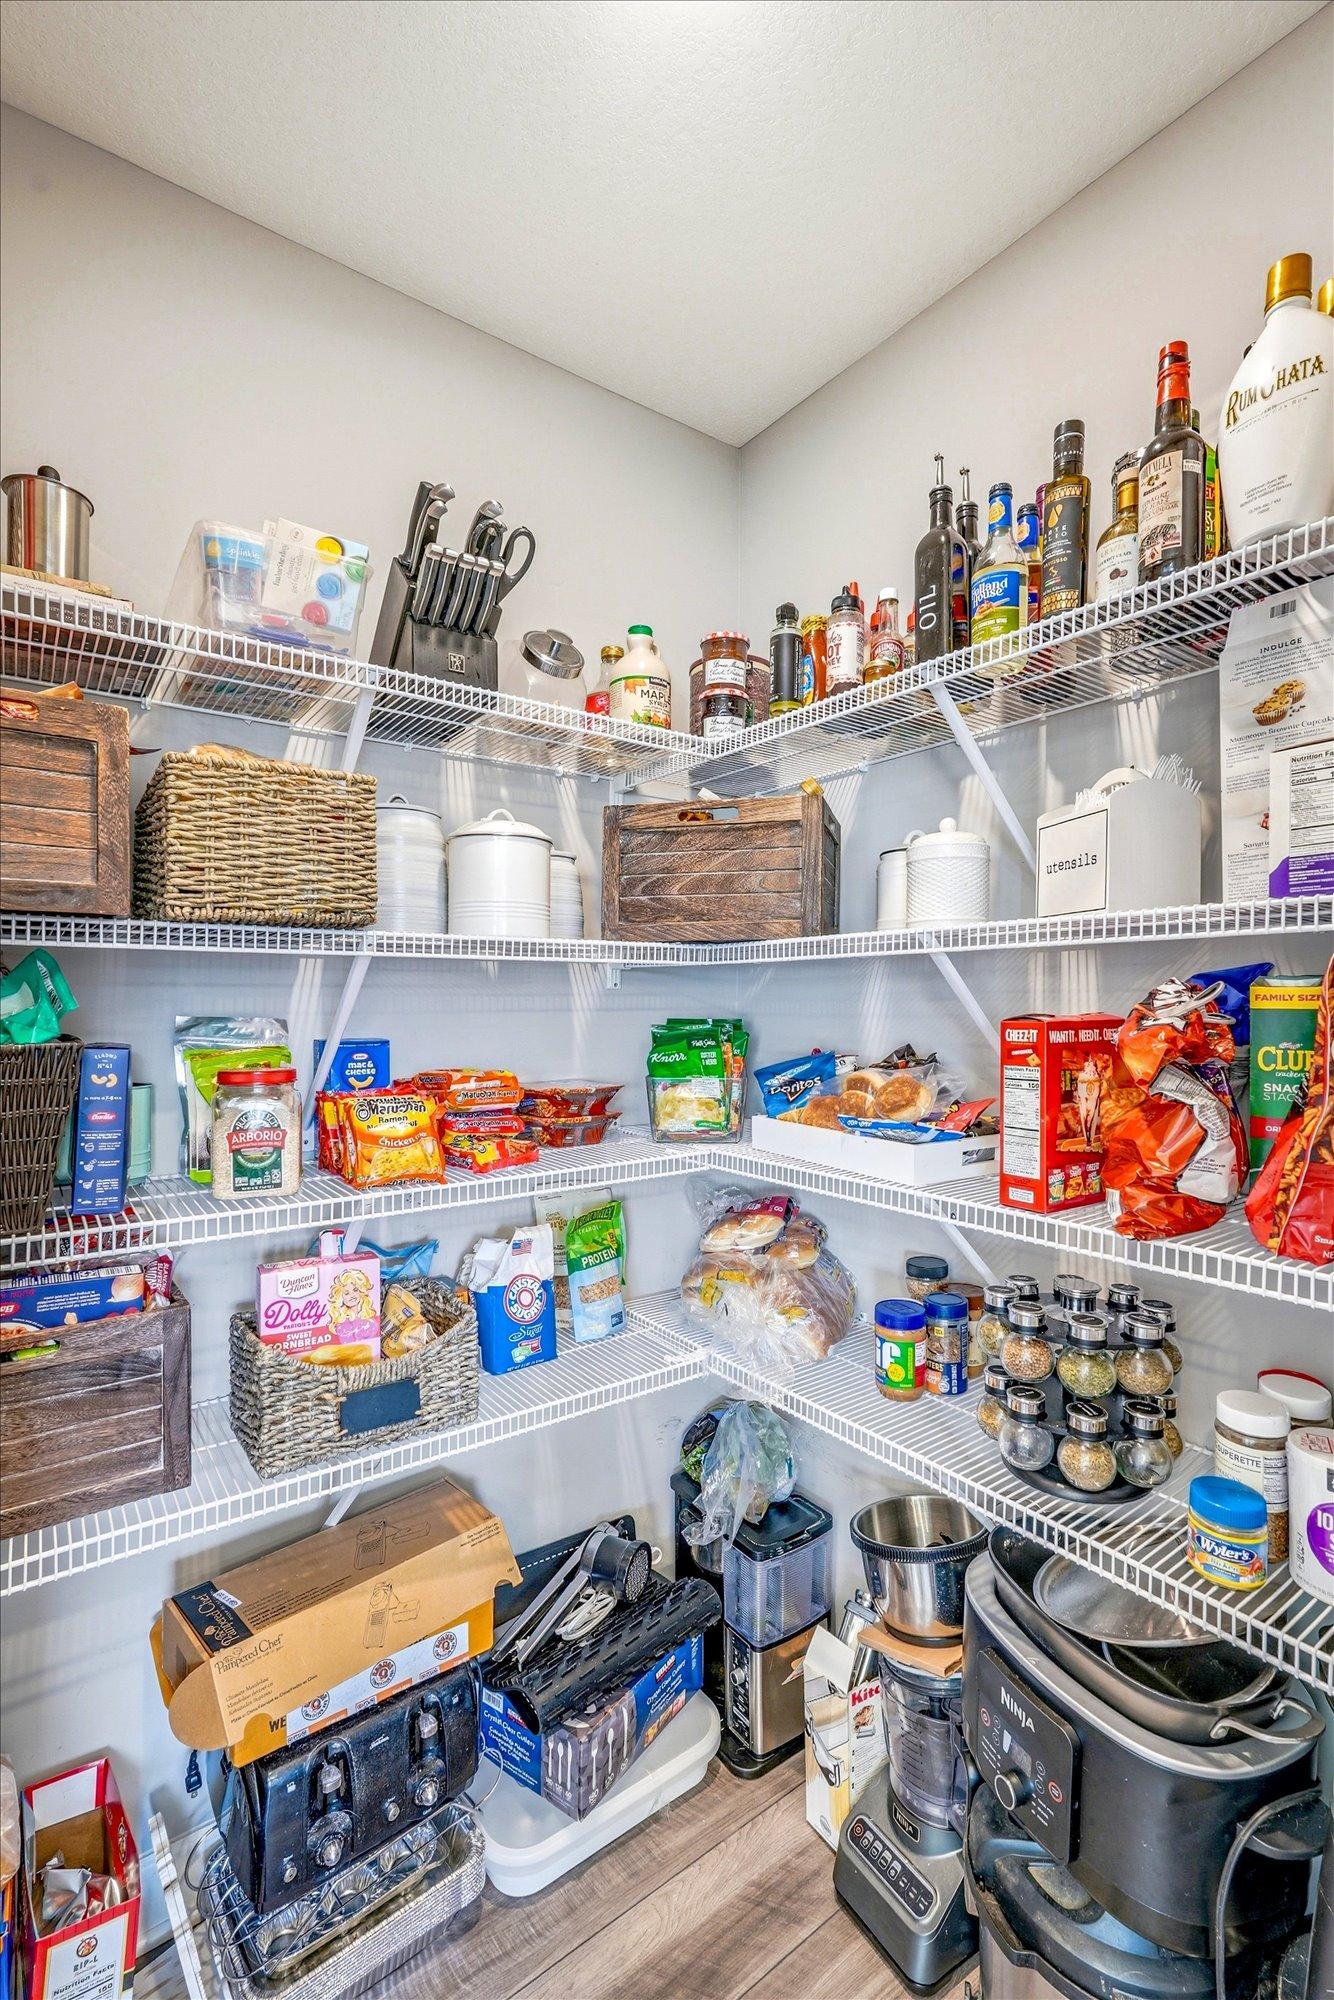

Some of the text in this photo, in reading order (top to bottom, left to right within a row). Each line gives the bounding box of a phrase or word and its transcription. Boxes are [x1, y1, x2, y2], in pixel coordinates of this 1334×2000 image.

[919, 584, 937, 631] OIL
[827, 642, 842, 659] OT
[1260, 637, 1303, 654] INDULGE
[1046, 853, 1098, 875] utensils
[1254, 994, 1294, 1002] FAMILY
[650, 1050, 688, 1063] Knorr
[770, 1076, 822, 1095] Doritos
[1264, 1083, 1301, 1094] SNAC
[1264, 1093, 1296, 1102] STAC
[378, 1115, 408, 1125] Ramen
[231, 1130, 283, 1145] ARBORIO
[378, 1137, 414, 1148] Chicken
[581, 1248, 617, 1269] PROTEIN
[1322, 1251, 1334, 1260] NE
[280, 1273, 315, 1290] Duncan
[285, 1281, 313, 1296] Hines
[509, 1277, 544, 1301] CRYSTAL
[264, 1299, 327, 1329] Dolly
[509, 1299, 543, 1320] SUGAR
[286, 1331, 313, 1341] SWEET
[875, 1337, 902, 1371] if
[1217, 1444, 1262, 1468] SUPERETTE
[1200, 1536, 1251, 1561] Wyler's
[214, 1646, 259, 1675] Pampered
[258, 1634, 284, 1653] Chef
[1000, 1685, 1036, 1735] NINJA
[53, 1963, 115, 1998] Nutrition Facts
